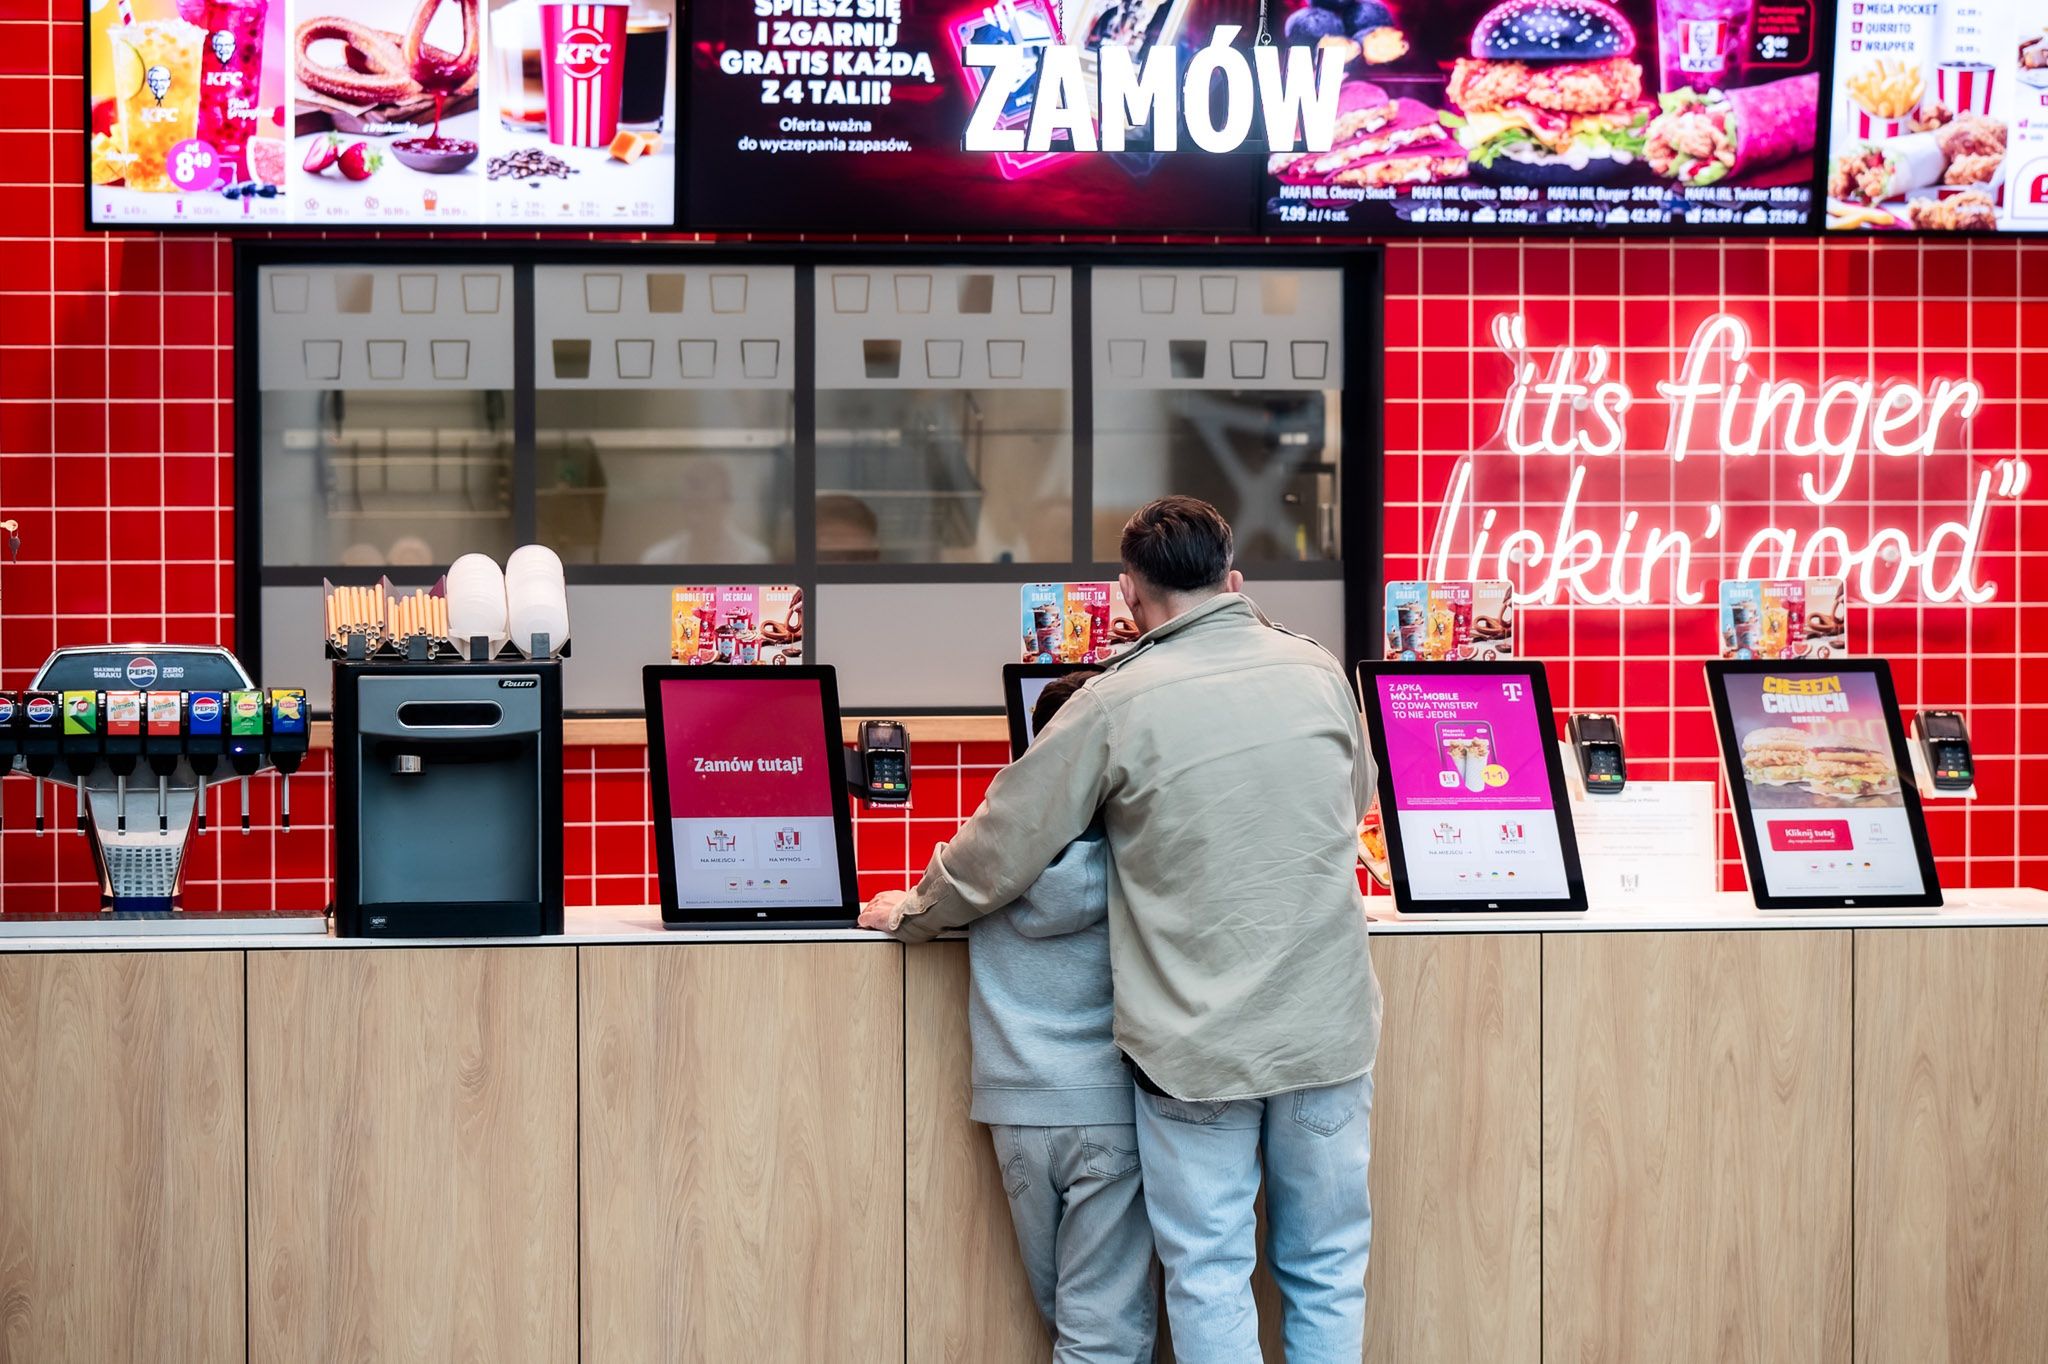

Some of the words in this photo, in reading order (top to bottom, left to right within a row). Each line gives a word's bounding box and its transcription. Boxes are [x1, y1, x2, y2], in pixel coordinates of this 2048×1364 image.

[758, 21, 768, 46] I
[772, 21, 898, 47] ZGARNIJ
[555, 42, 612, 65] KFC
[720, 50, 829, 76] GRATIS
[833, 46, 936, 84] KAŻDĄ
[206, 71, 244, 87] KFC
[761, 80, 780, 104] Z
[783, 80, 805, 104] 4
[808, 80, 892, 105] TALII!
[961, 25, 1347, 153] ZAMÓW
[140, 107, 180, 123] KFC
[780, 117, 825, 133] Oferta
[827, 118, 872, 133] ważna
[184, 142, 200, 153] od
[738, 136, 758, 151] do
[760, 138, 846, 154] wyczerpania
[848, 137, 913, 153] zapasów.
[1279, 185, 1311, 199] MAFIA
[1411, 186, 1443, 200] MAFIA
[1279, 205, 1307, 222] 7.99
[1660, 315, 1980, 504] finger
[1435, 462, 1722, 605] lickin’
[128, 668, 156, 676] PEPSI
[1388, 683, 1395, 692] Z
[1396, 683, 1423, 693] APKĄ
[1390, 691, 1413, 701] MÓJ
[1414, 692, 1460, 701] T-MOBILE
[1391, 702, 1407, 710] CO
[1407, 702, 1431, 710] DWA
[1431, 701, 1479, 710] TWISTERY
[1761, 692, 1850, 713] CRUNCH
[1393, 710, 1407, 719] TO
[1407, 711, 1425, 719] NIE
[1425, 710, 1457, 719] JEDEN
[693, 756, 754, 773] Zamów
[757, 756, 804, 775] tutaj!
[1785, 828, 1813, 839] Kliknij
